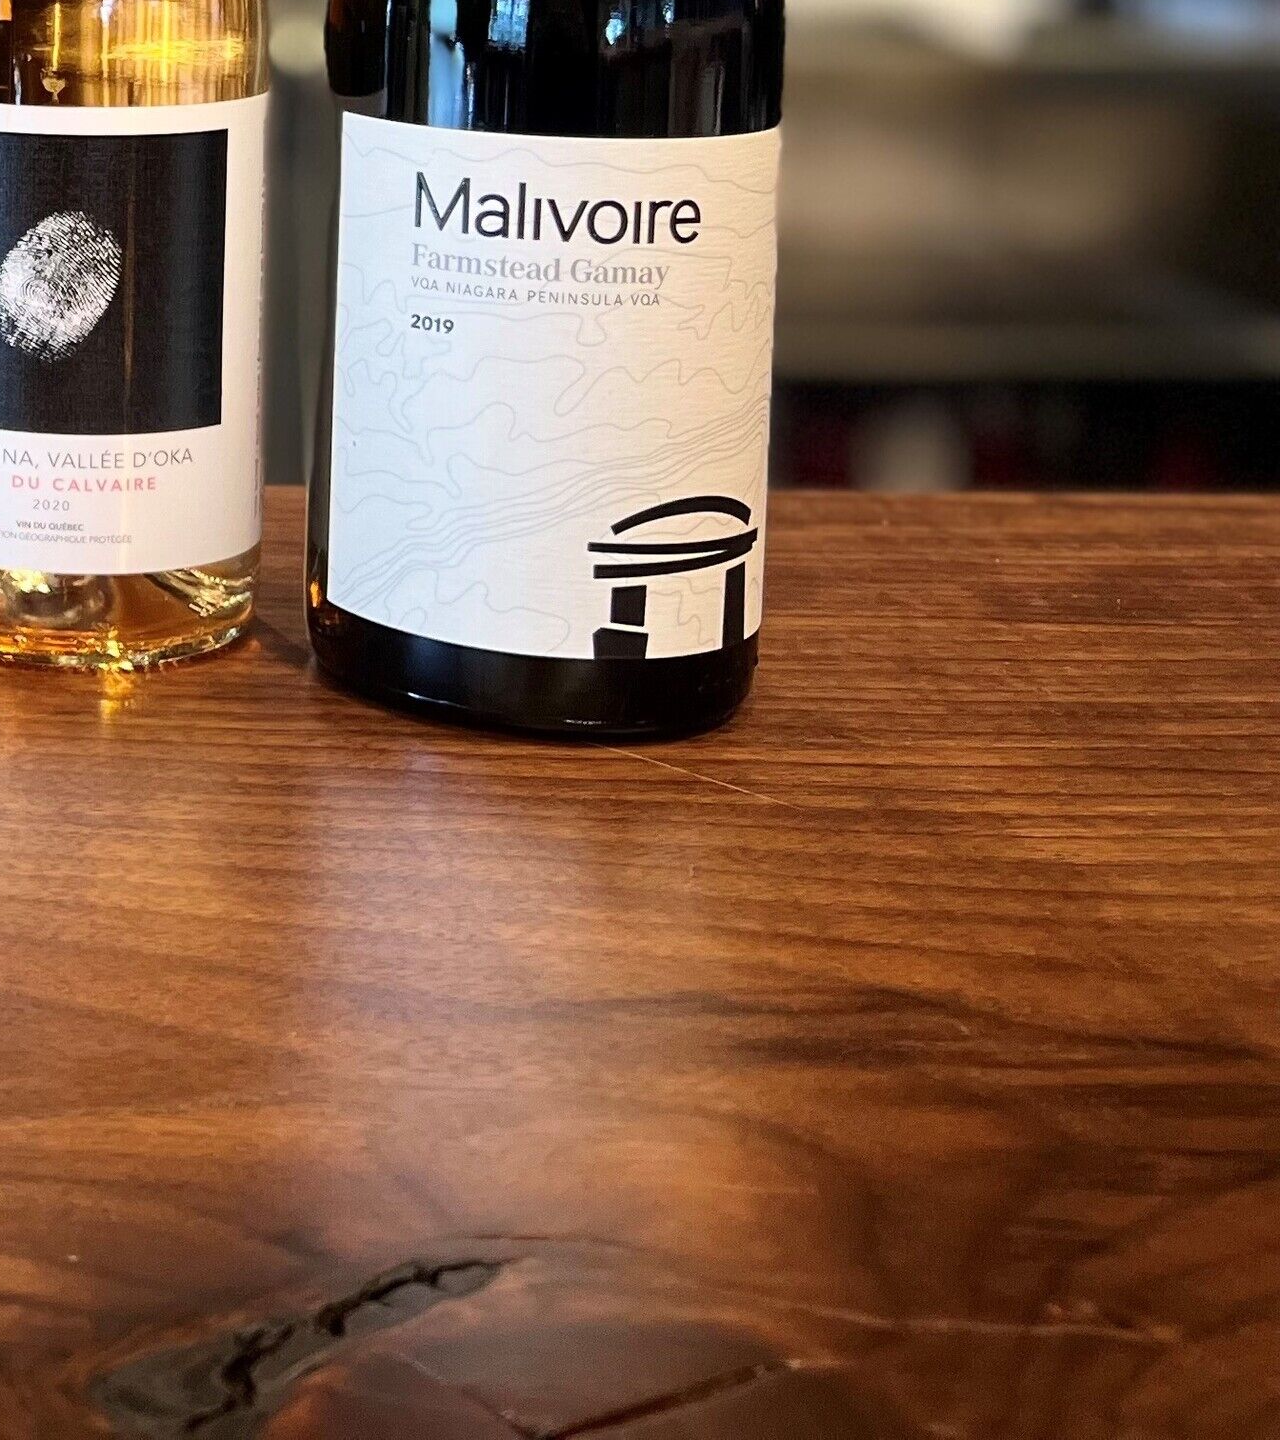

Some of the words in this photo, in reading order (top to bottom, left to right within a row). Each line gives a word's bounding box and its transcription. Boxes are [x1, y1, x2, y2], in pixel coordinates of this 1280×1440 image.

[413, 171, 702, 246] Malivoire
[411, 243, 561, 282] Farmstead
[570, 259, 670, 291] Gamay
[411, 276, 439, 292] VQA
[446, 280, 518, 302] NIAGARA
[527, 289, 624, 307] PENINSULA
[630, 292, 661, 307] VQA
[410, 314, 454, 335] 2019
[47, 450, 125, 470] VALLÉE
[132, 447, 194, 468] D'OKA
[11, 475, 40, 491] DU
[52, 476, 157, 492] CALVAIRE
[32, 498, 70, 511] 2020
[16, 520, 31, 529] VIN
[34, 522, 46, 530] DU
[48, 521, 84, 532] QUÉBEC
